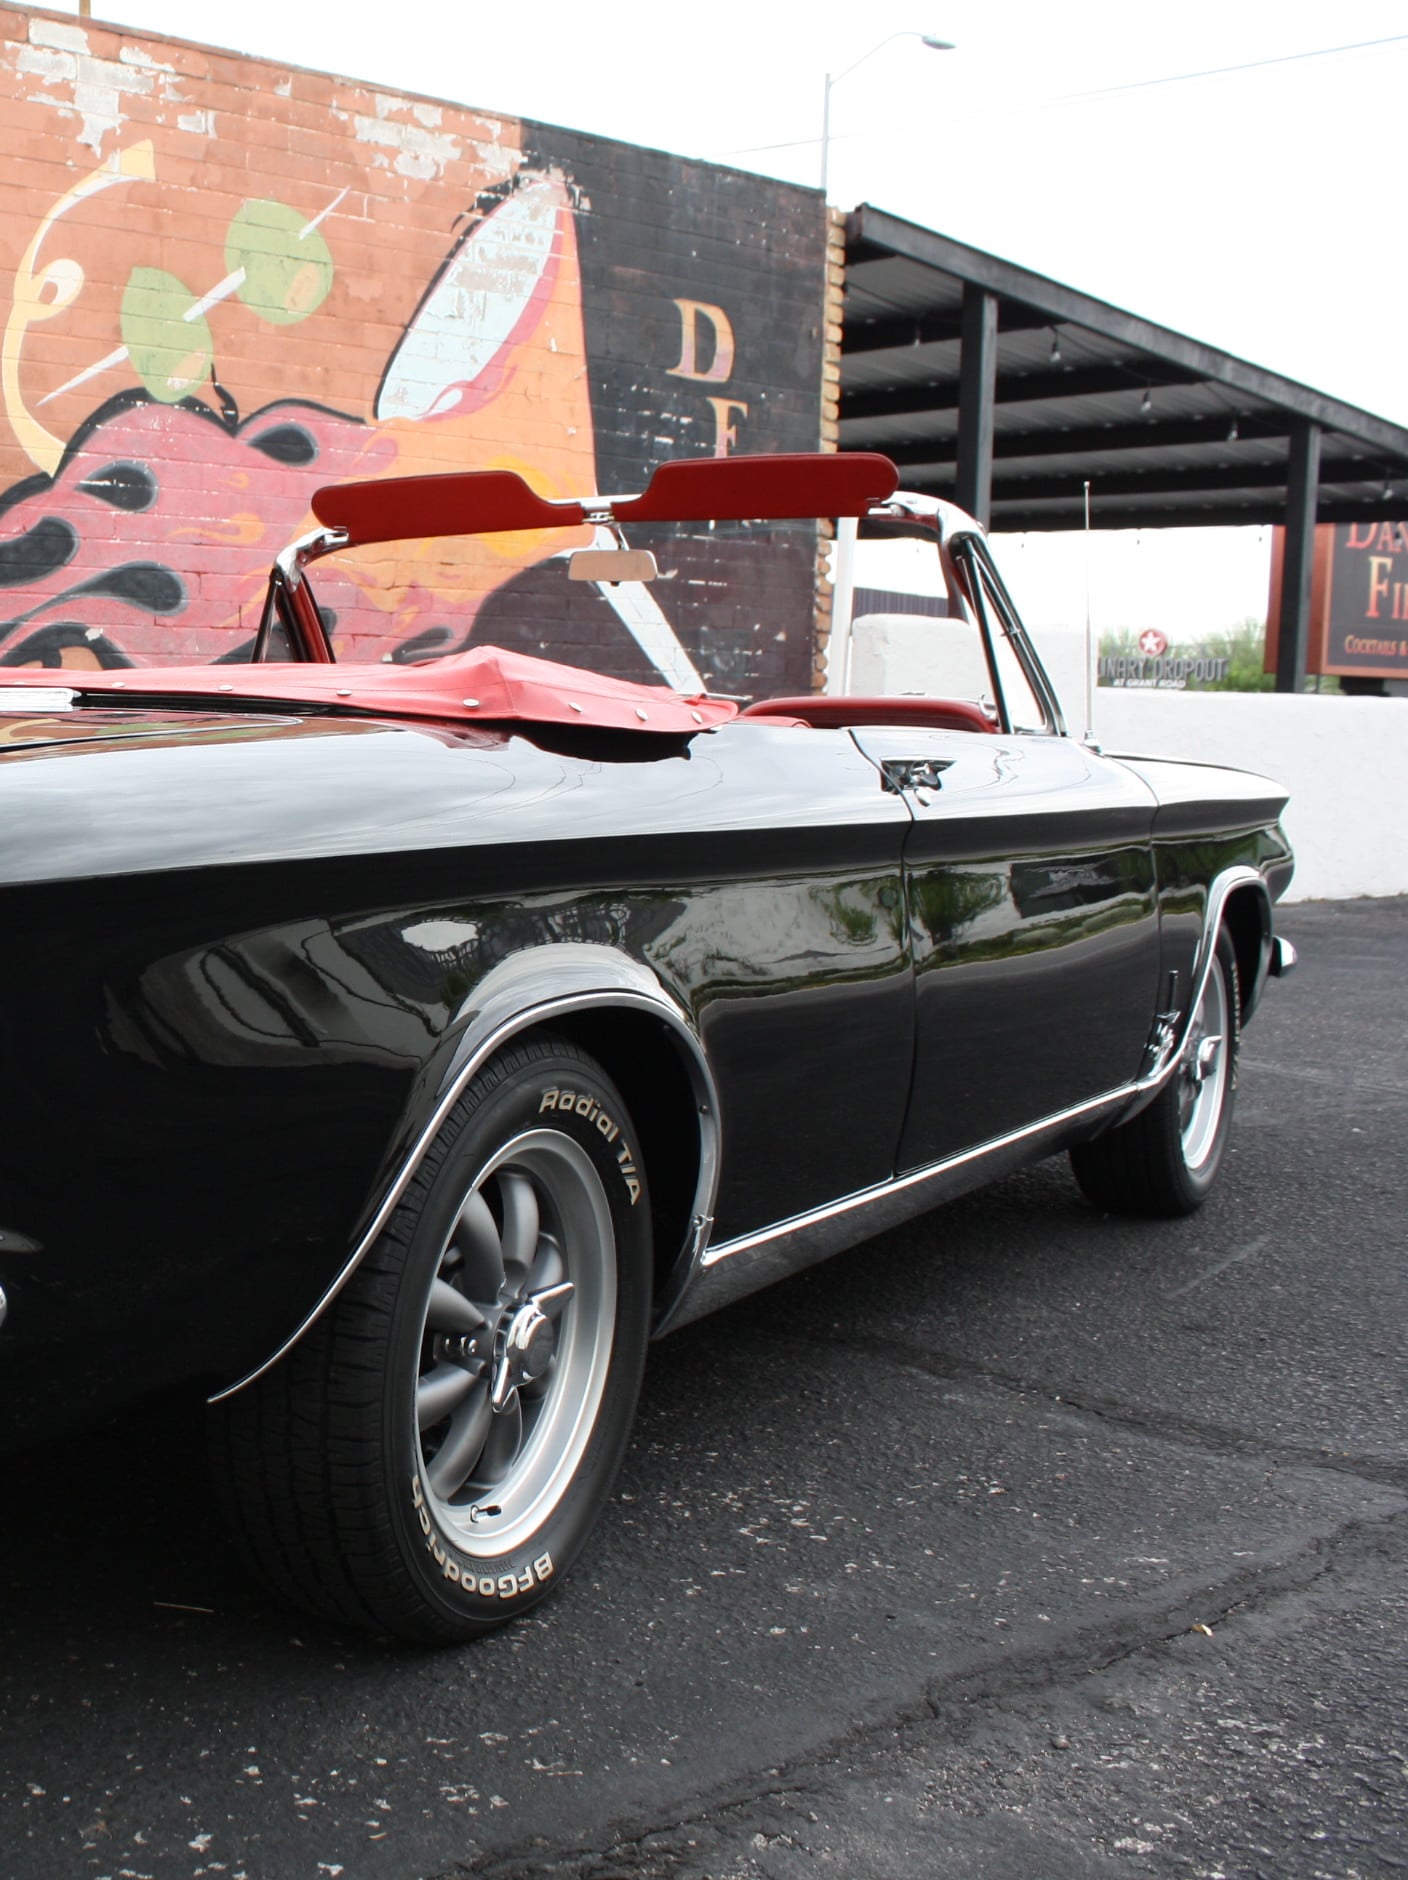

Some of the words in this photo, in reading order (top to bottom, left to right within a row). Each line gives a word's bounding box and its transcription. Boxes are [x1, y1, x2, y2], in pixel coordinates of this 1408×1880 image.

[666, 298, 735, 383] D
[706, 396, 748, 458] F
[1153, 657, 1227, 681] DROPOUT
[539, 1087, 620, 1143] Radial
[412, 1474, 554, 1599] BFGoodrich
